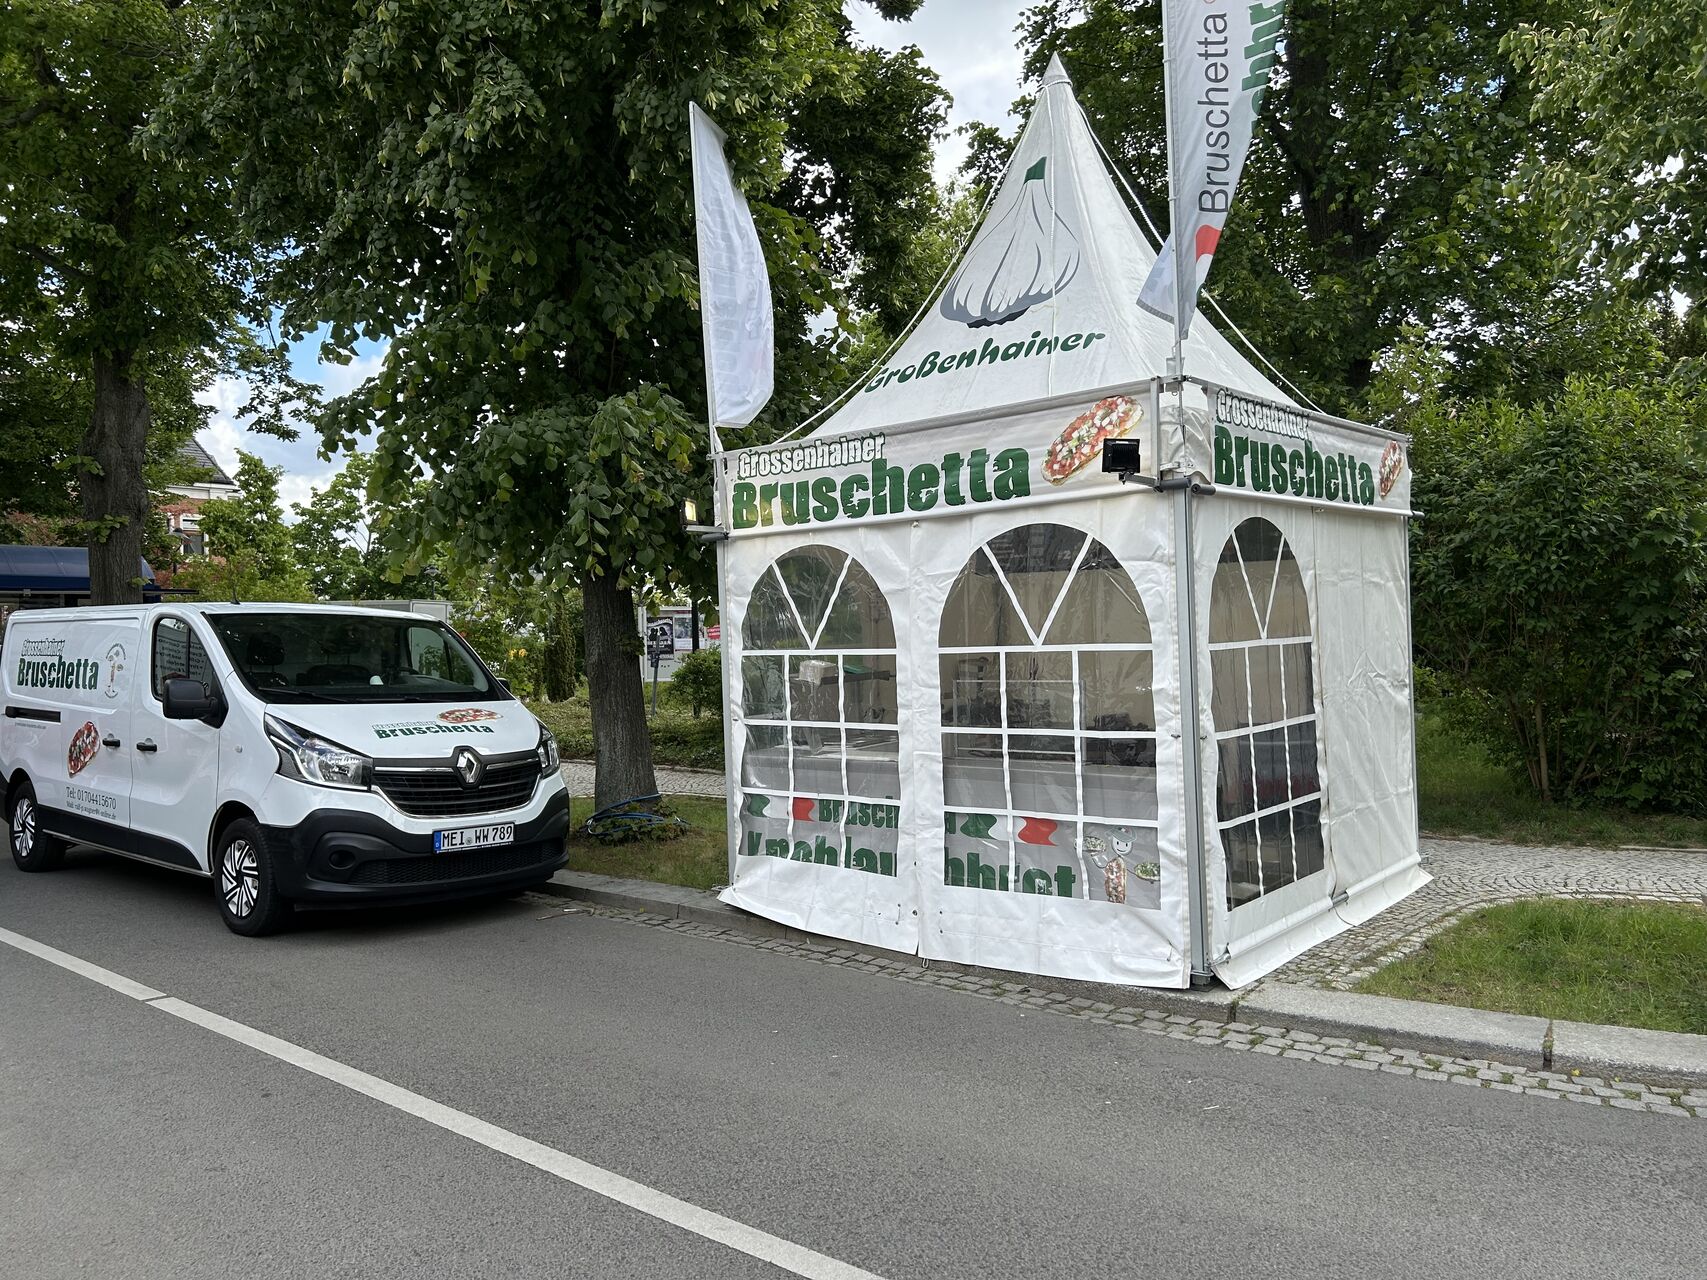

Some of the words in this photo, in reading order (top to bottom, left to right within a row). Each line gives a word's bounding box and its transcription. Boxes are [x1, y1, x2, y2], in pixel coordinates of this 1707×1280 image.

[1197, 12, 1230, 213] Bruschetta
[865, 330, 1106, 393] Großenhainer
[1216, 388, 1311, 440] Grossenhainer
[738, 432, 886, 480] Grossenhainer
[1214, 424, 1375, 506] Bruschetta
[732, 447, 1031, 529] Bruschetta
[17, 655, 99, 690] Bruschetta
[373, 723, 495, 739] Bruschetta
[77, 789, 117, 810] 01704415670
[442, 831, 465, 847] MEI
[474, 828, 490, 843] WW
[492, 825, 513, 841] 789
